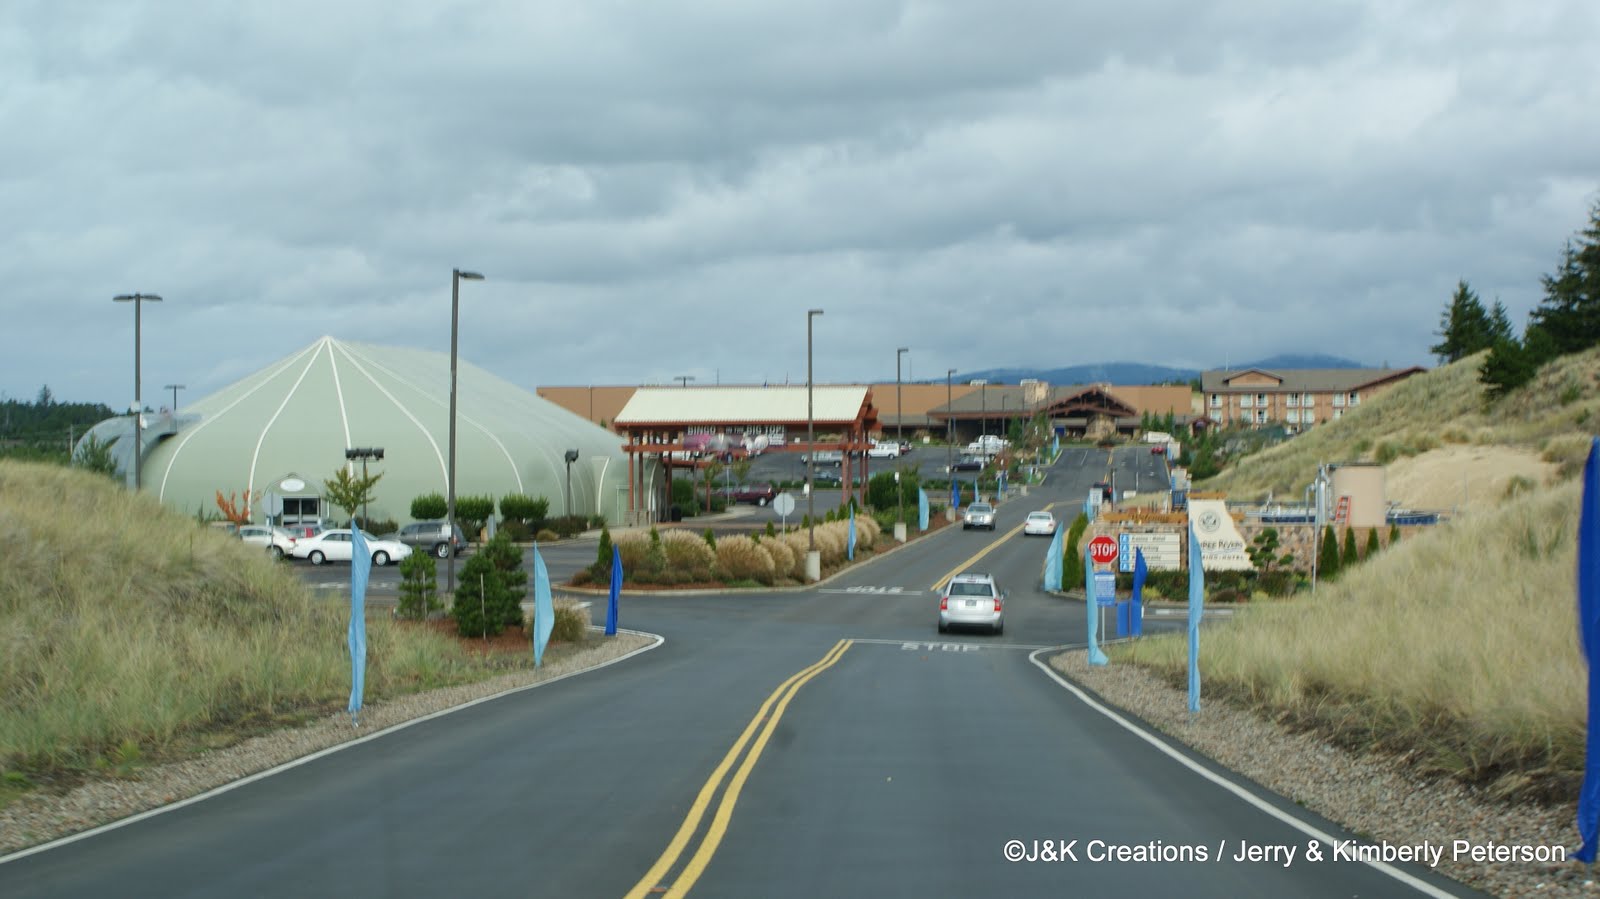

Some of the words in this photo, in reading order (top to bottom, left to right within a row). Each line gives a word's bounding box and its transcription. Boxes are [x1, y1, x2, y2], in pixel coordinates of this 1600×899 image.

[688, 425, 716, 435] BINGO
[747, 425, 762, 435] BIG
[1090, 543, 1116, 556] STOP
[901, 642, 980, 652] STOP
